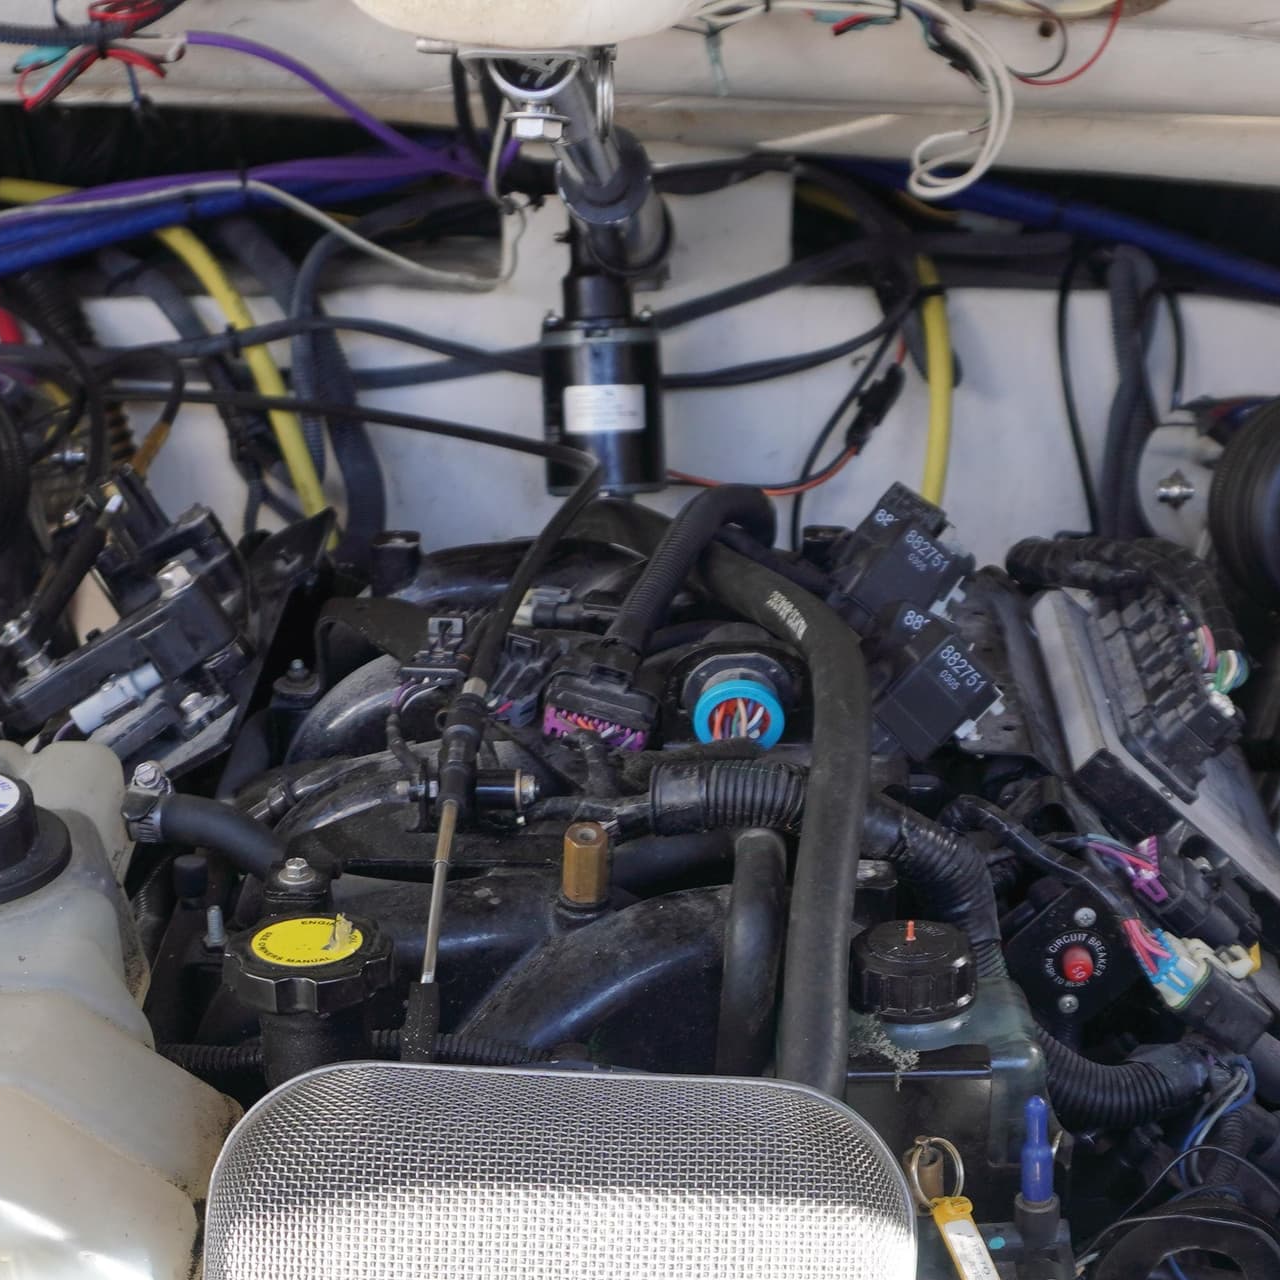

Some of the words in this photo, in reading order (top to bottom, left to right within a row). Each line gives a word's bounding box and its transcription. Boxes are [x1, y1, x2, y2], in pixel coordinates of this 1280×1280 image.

[905, 529, 950, 574] 882751
[903, 609, 931, 631] 88
[940, 644, 988, 694] 882751
[285, 956, 333, 964] MANUAL
[1048, 932, 1089, 953] CIRCUIT
[1087, 936, 1108, 977] BREAKER
